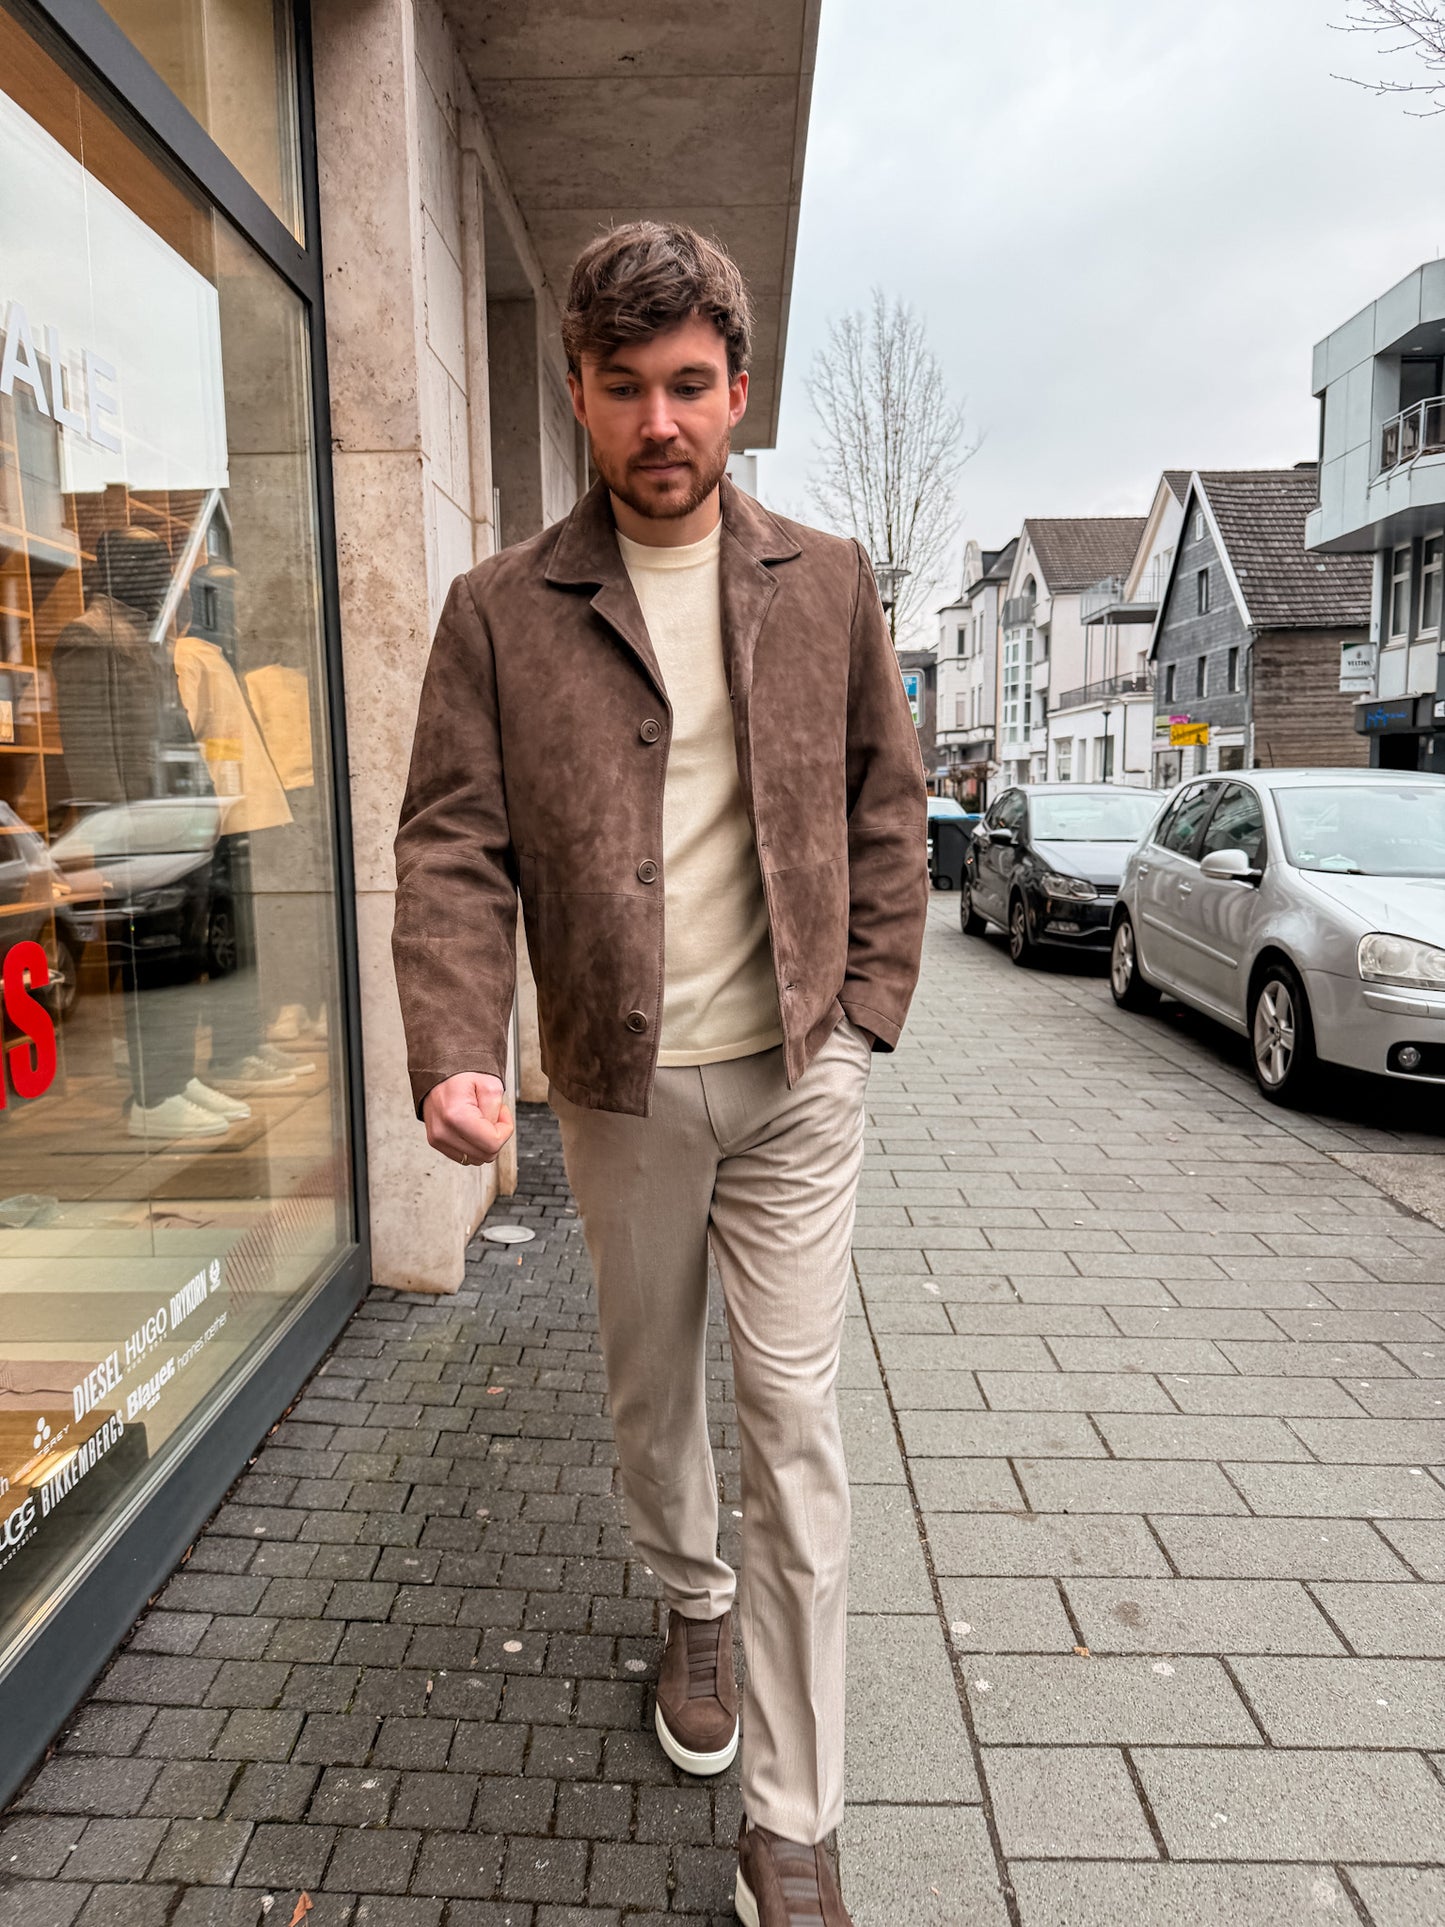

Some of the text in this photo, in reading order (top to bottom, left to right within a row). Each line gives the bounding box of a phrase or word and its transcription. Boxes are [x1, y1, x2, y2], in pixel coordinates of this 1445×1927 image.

[0, 940, 57, 1111] S
[125, 1307, 167, 1365] HUGO
[170, 1269, 207, 1330] DRYKORN
[72, 1350, 123, 1424] DIESEL
[41, 1409, 124, 1518] BIKKEMBERGS
